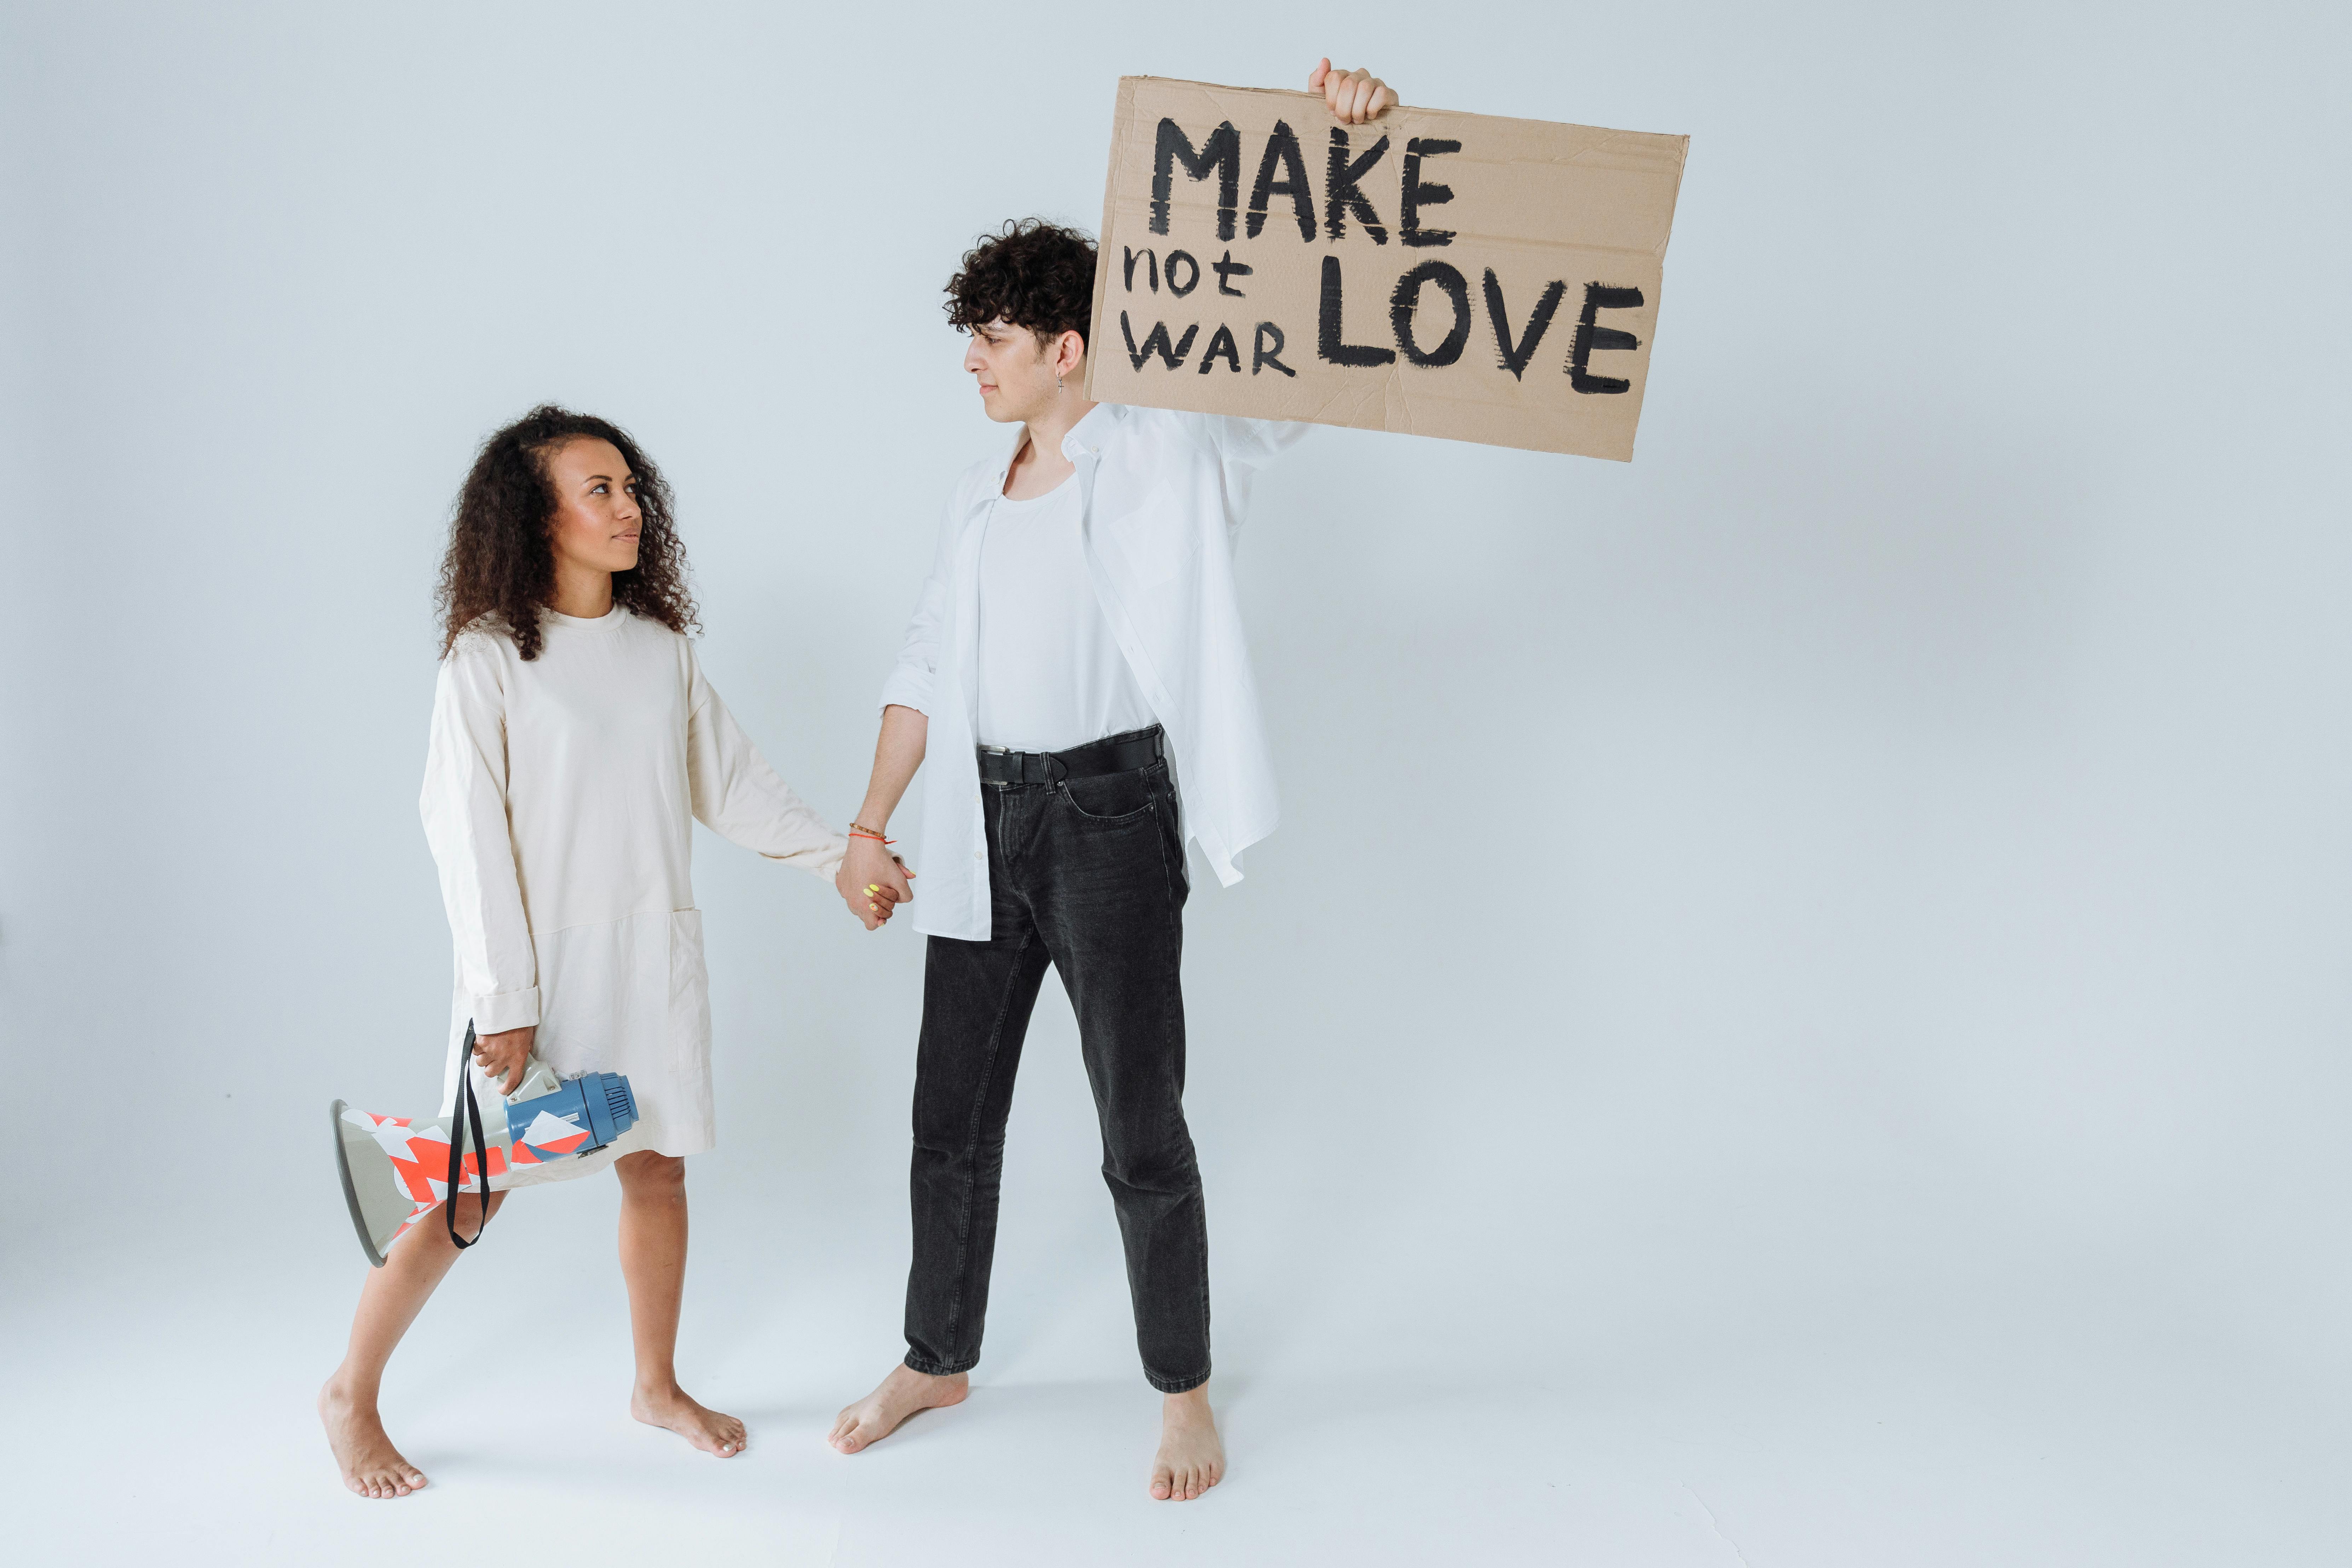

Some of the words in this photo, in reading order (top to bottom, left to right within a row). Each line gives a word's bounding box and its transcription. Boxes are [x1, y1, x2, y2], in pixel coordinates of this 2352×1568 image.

[1149, 117, 1462, 246] MAKE
[1123, 245, 1253, 298] not
[1120, 310, 1297, 377] WAR
[1317, 255, 1645, 394] LOVE
